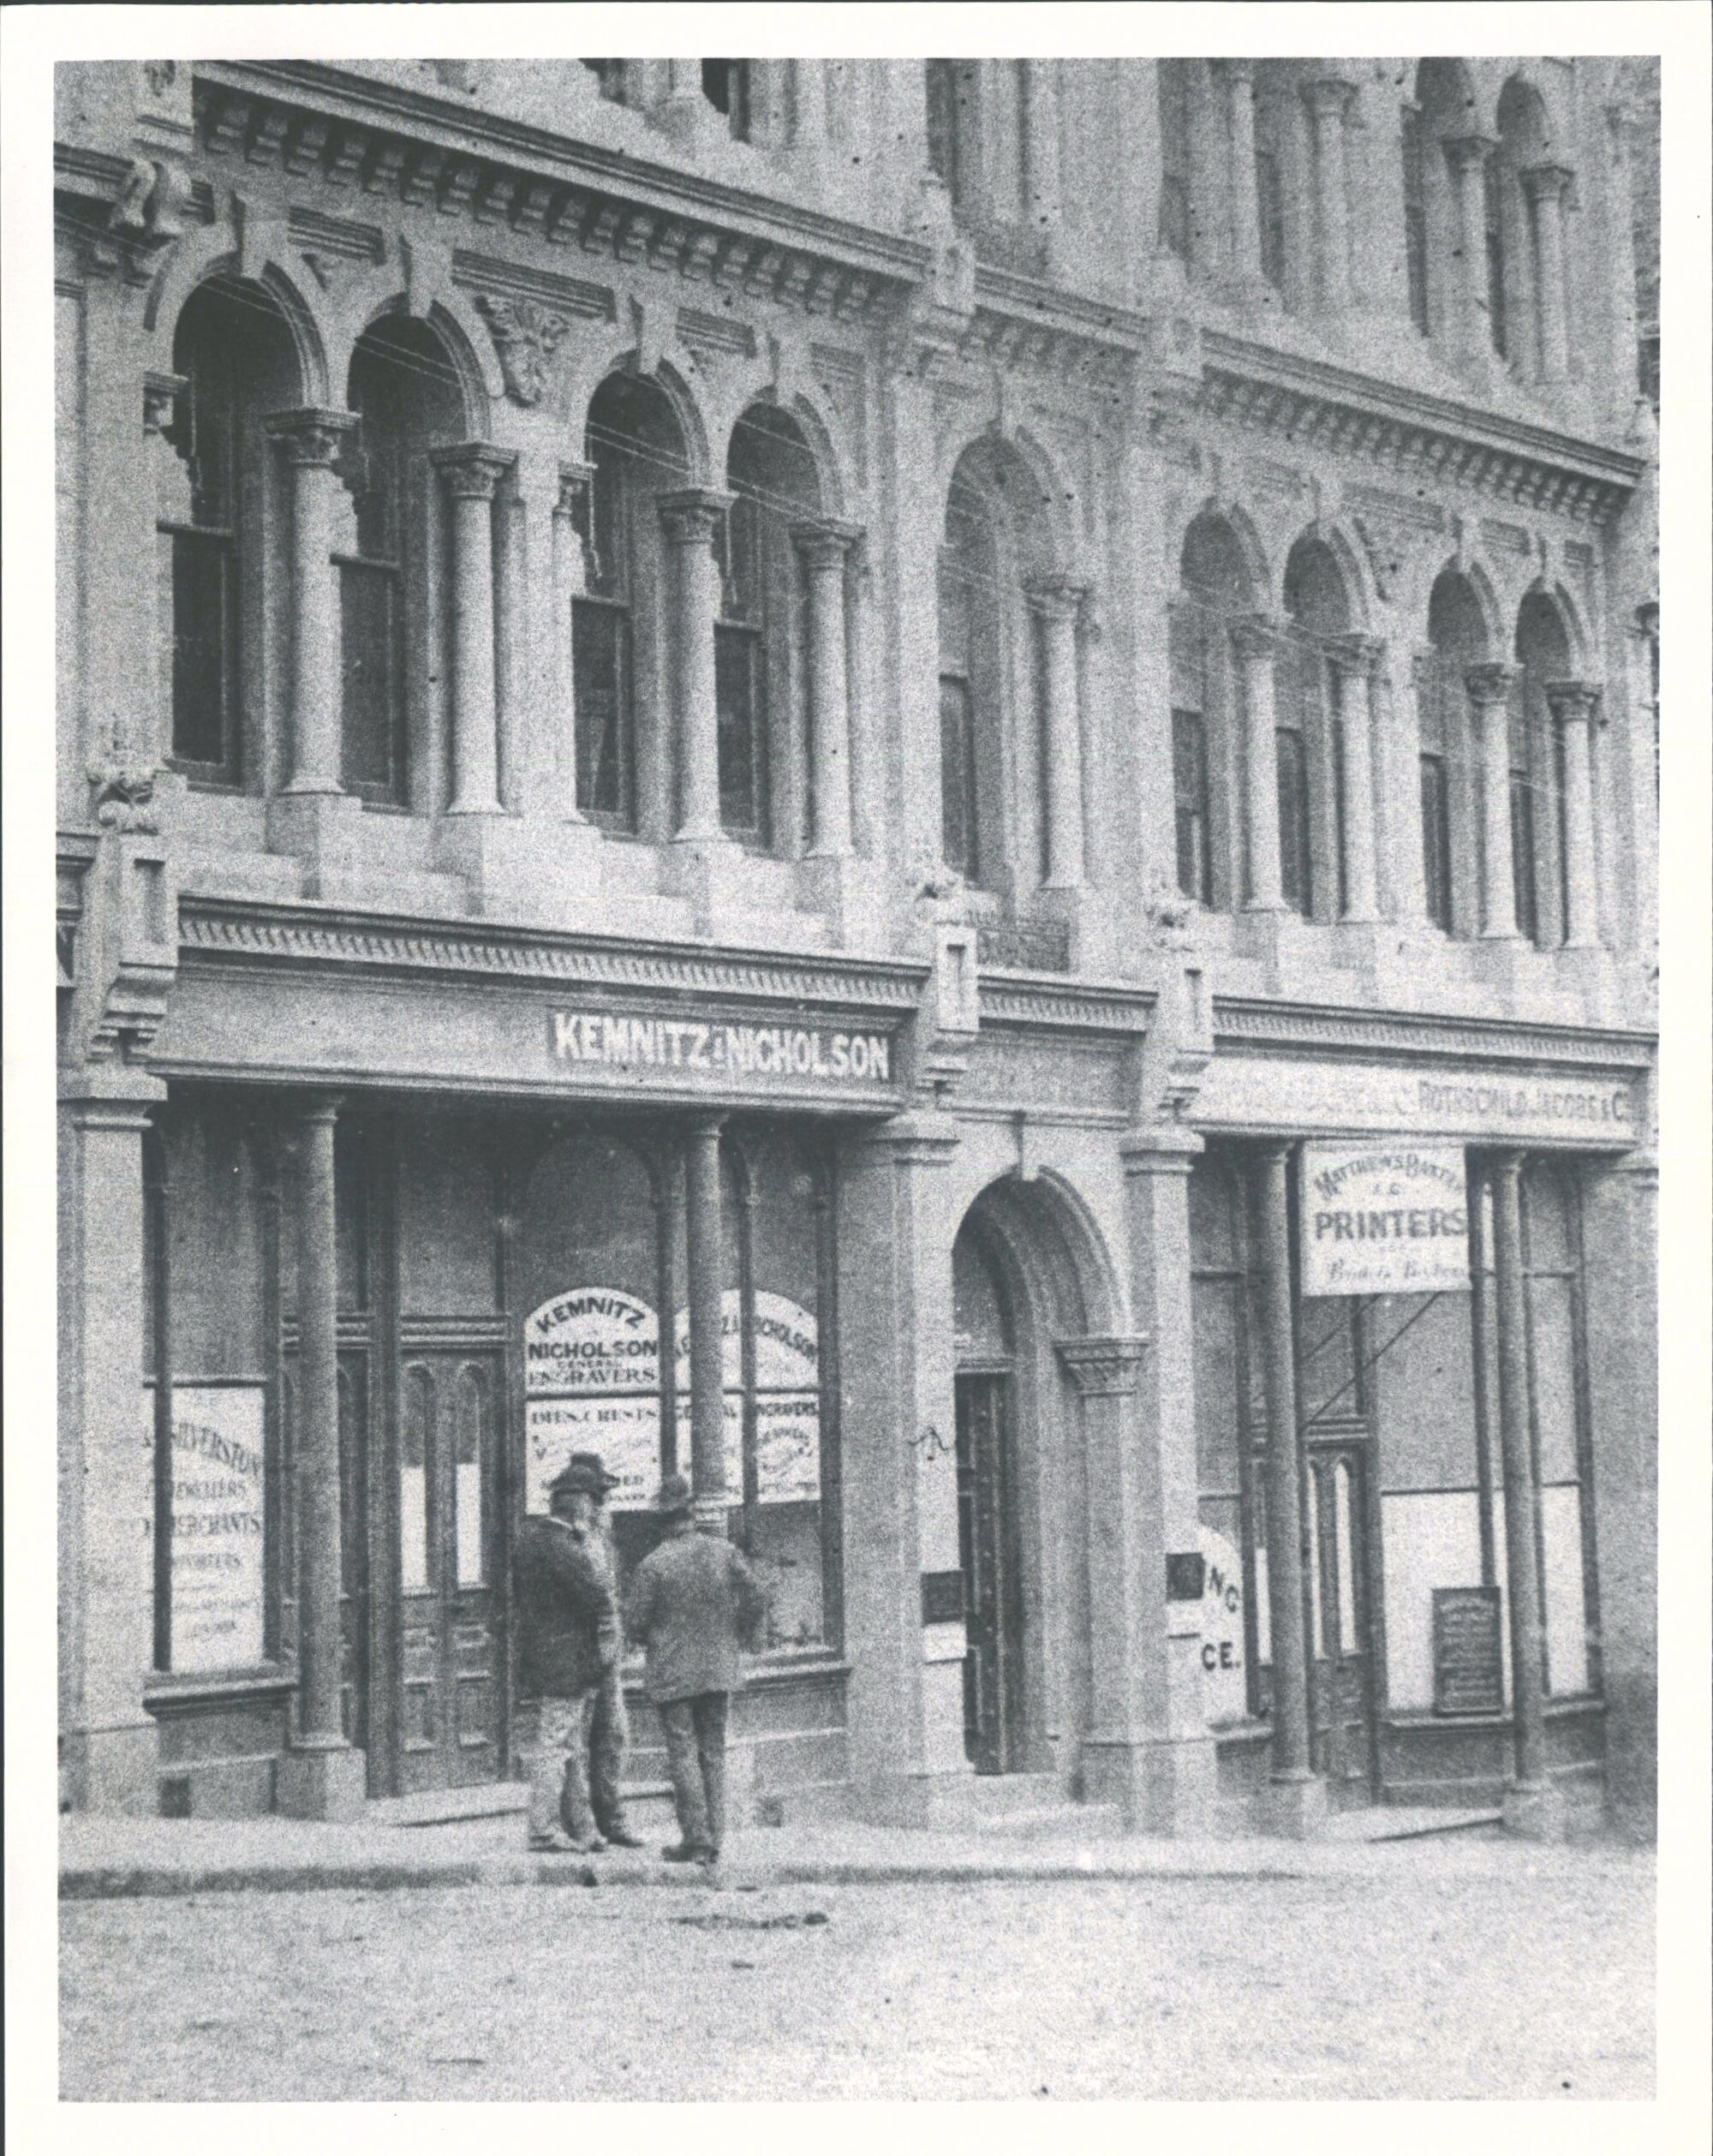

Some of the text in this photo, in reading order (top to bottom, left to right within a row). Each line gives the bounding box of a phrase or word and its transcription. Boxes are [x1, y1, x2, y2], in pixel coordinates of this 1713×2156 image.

[554, 1012, 711, 1068] KEMNITZ
[726, 1025, 889, 1080] NICHOLSON
[1315, 1208, 1466, 1241] PRINTERS
[535, 1296, 647, 1334] KEMNITZ
[528, 1340, 657, 1360] NICHOLSON
[528, 1368, 656, 1387] ENGRAVERS
[1209, 1567, 1239, 1613] NG
[1203, 1641, 1240, 1671] CE.
